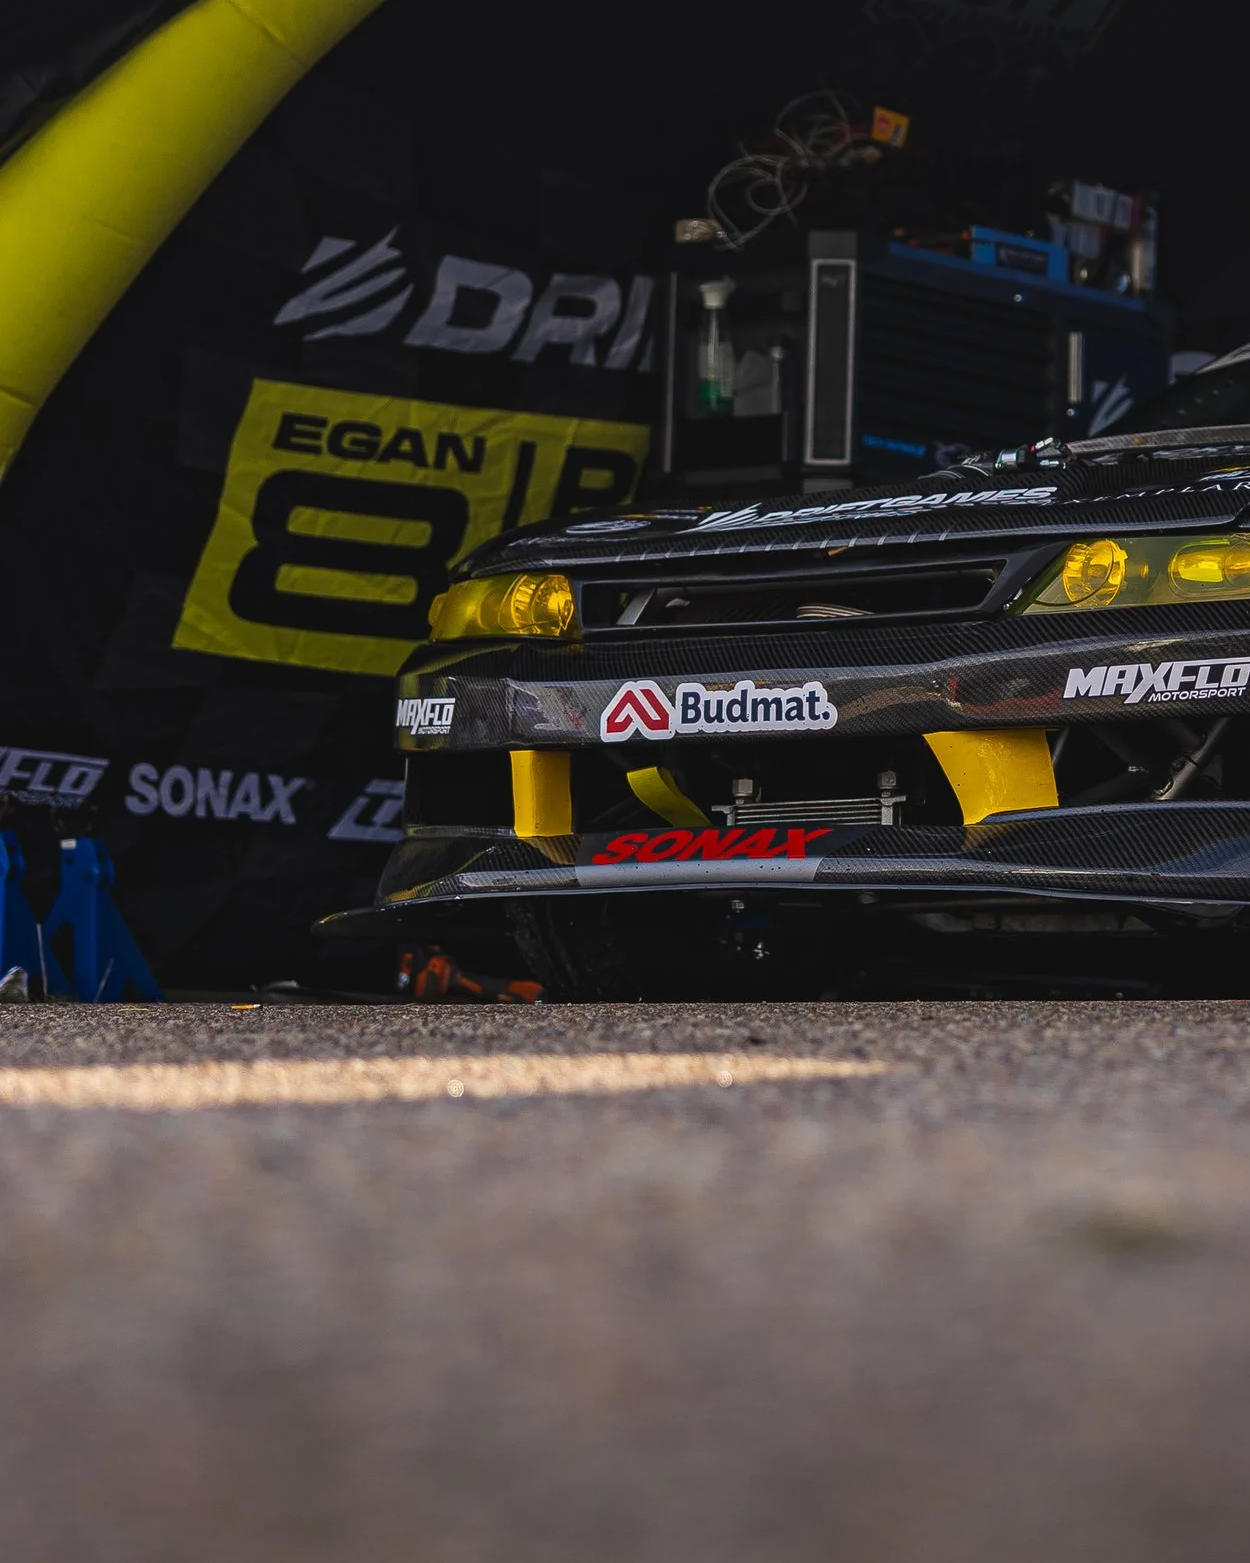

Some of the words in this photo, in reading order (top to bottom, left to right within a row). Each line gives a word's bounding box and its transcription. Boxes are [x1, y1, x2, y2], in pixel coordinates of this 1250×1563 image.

[403, 254, 656, 372] DRI
[271, 413, 487, 473] EGAN
[227, 468, 471, 639] 8
[1148, 687, 1247, 703] MOTORSPORT
[0, 746, 111, 796] FLO
[124, 761, 306, 826] SONAX
[592, 828, 836, 866] SONAX
